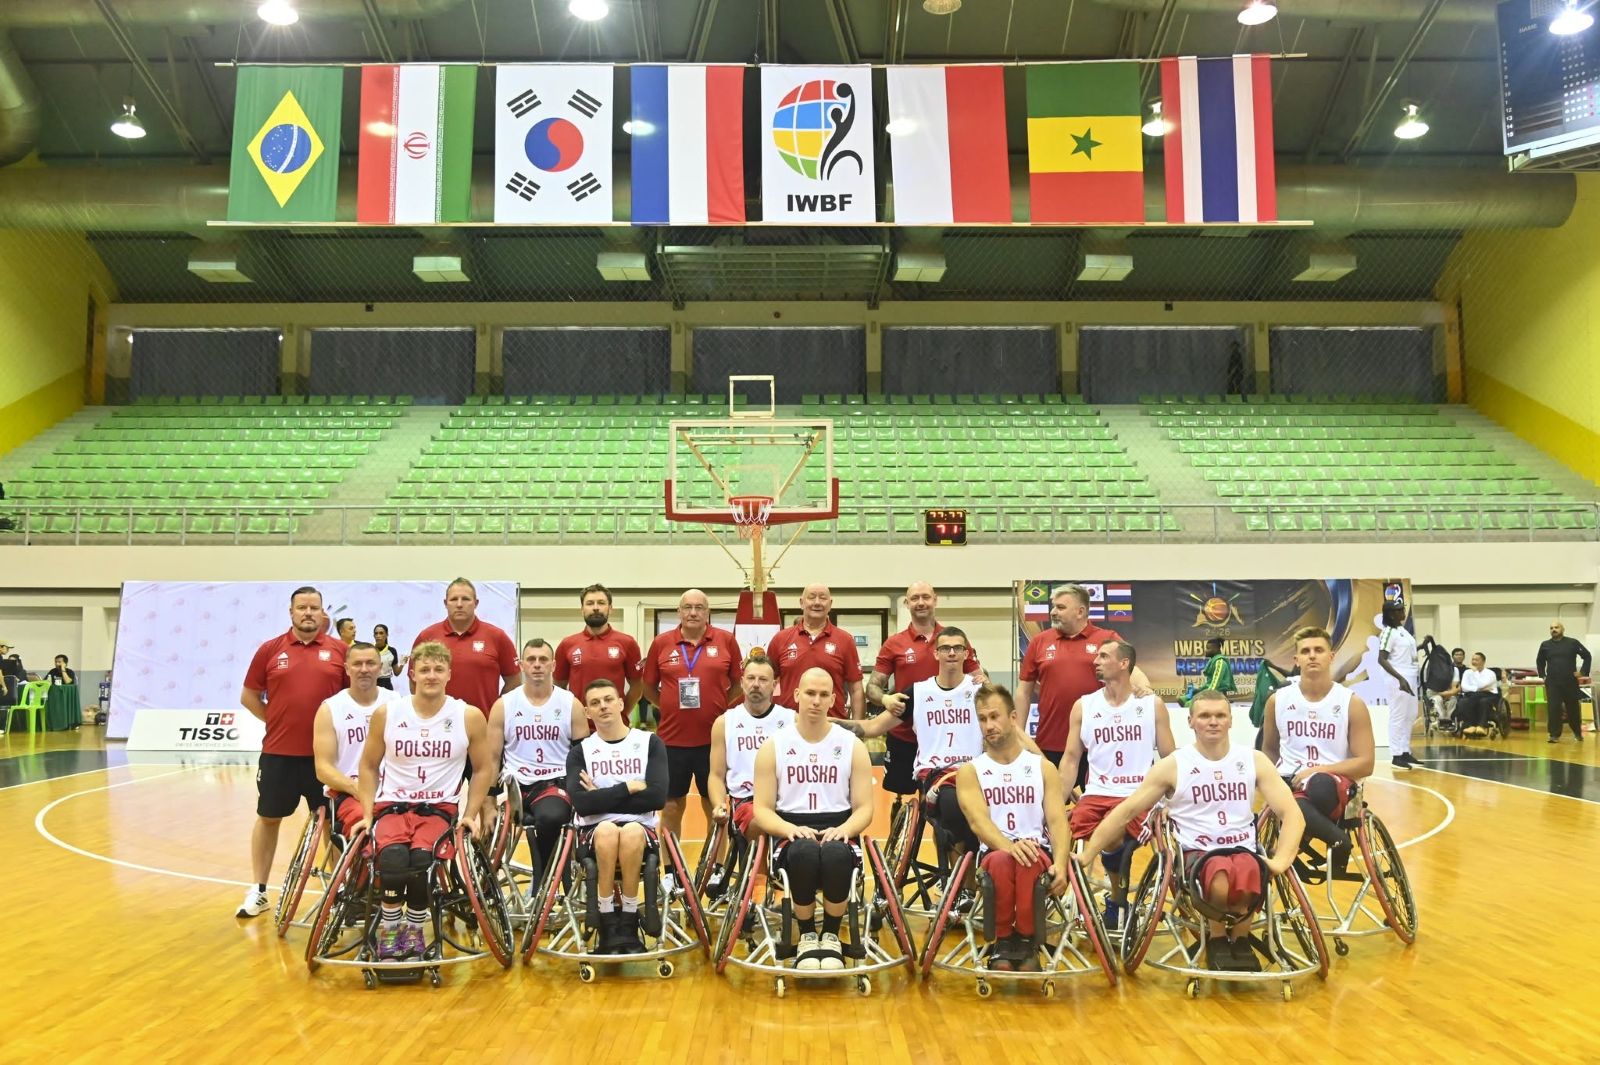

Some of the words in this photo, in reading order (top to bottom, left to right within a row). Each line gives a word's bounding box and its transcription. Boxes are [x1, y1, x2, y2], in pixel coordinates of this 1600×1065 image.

[787, 194, 852, 212] IWBF
[1206, 628, 1230, 636] 226
[1220, 640, 1264, 656] MEN'S
[927, 708, 971, 726] POLSKA
[516, 724, 560, 741] POLSKA
[1094, 724, 1142, 744] POLSKA
[1287, 720, 1335, 740] POLSKA
[738, 735, 769, 752] POLS
[947, 733, 954, 747] 7
[396, 740, 451, 758] POLSKA
[536, 748, 544, 763] 3
[1306, 745, 1318, 760] 10
[1116, 750, 1123, 766] 8
[417, 766, 426, 783] 4
[592, 758, 641, 776] POLSKA
[787, 765, 838, 784] POLSKA
[1112, 775, 1144, 784] ORLEN
[410, 790, 444, 800] ORLEN
[809, 793, 817, 810] 11
[984, 785, 1035, 806] POLSKA
[1192, 782, 1246, 804] POLSKA
[1007, 812, 1016, 830] 6
[1217, 811, 1227, 826] 9
[1216, 832, 1249, 845] ORLEN
